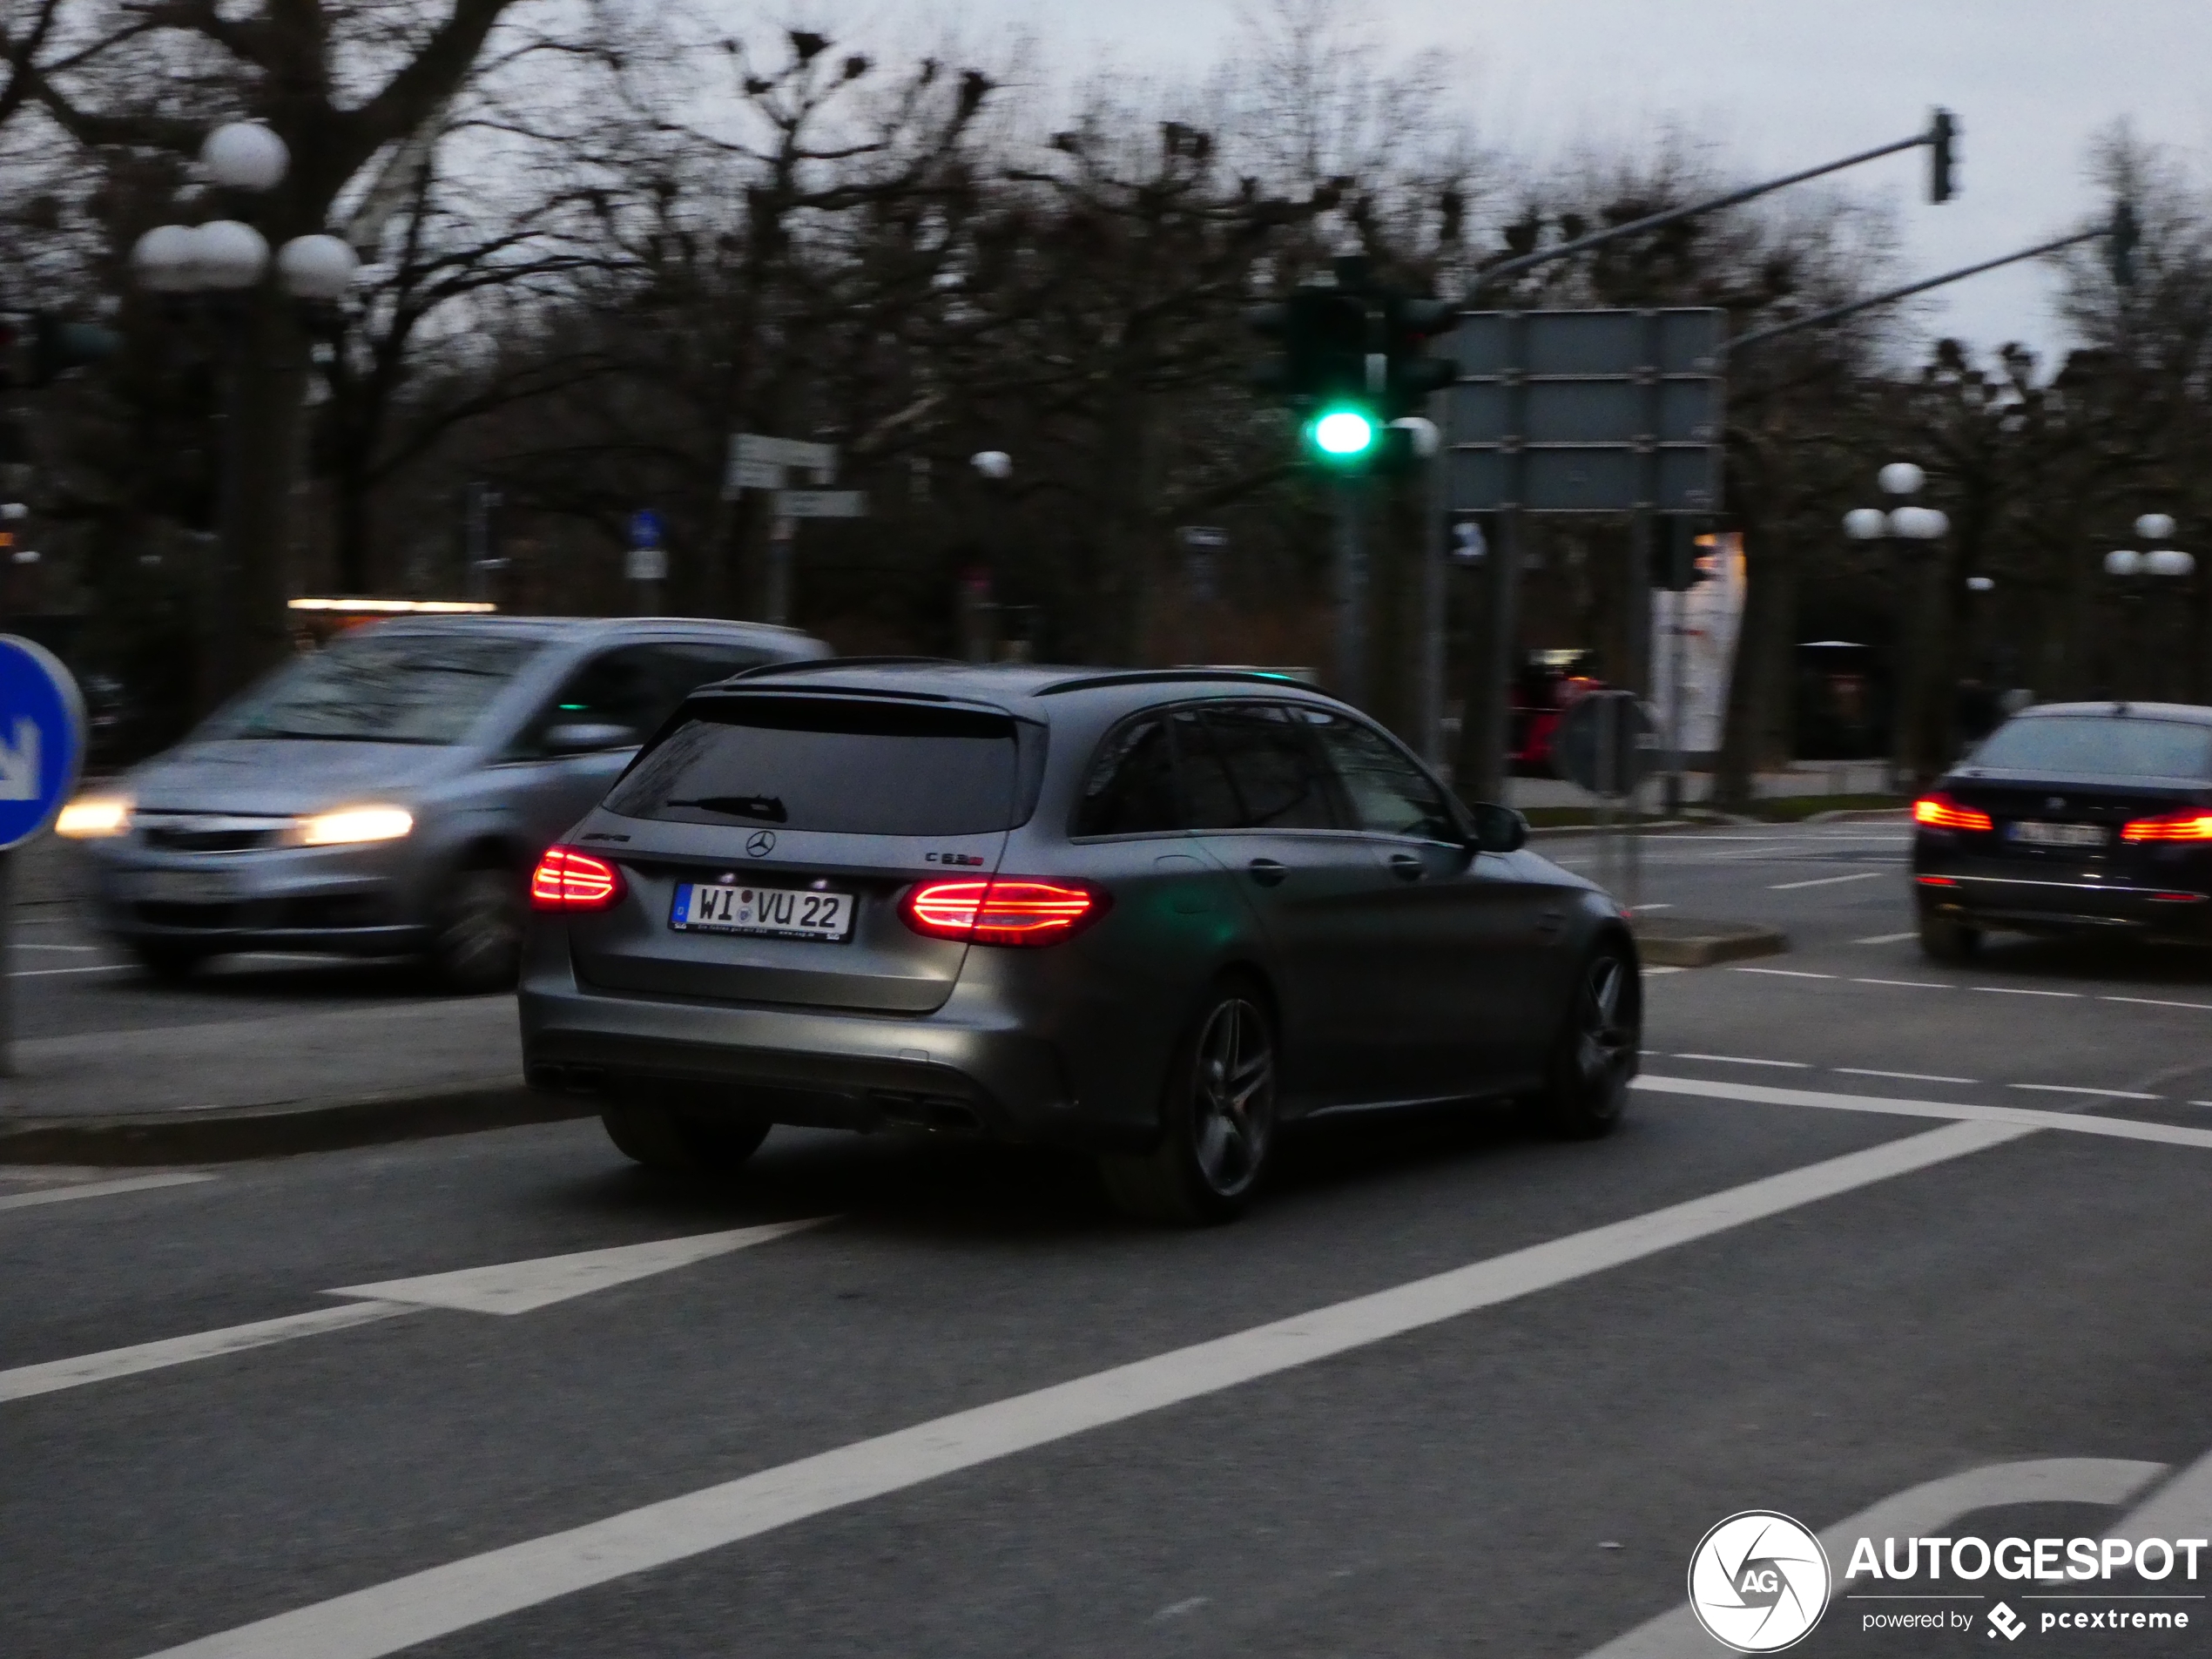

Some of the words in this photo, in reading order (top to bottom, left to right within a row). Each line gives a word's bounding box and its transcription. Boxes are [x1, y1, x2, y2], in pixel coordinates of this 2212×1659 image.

[699, 888, 733, 921] WI
[759, 892, 795, 925] VU
[800, 896, 840, 927] 22
